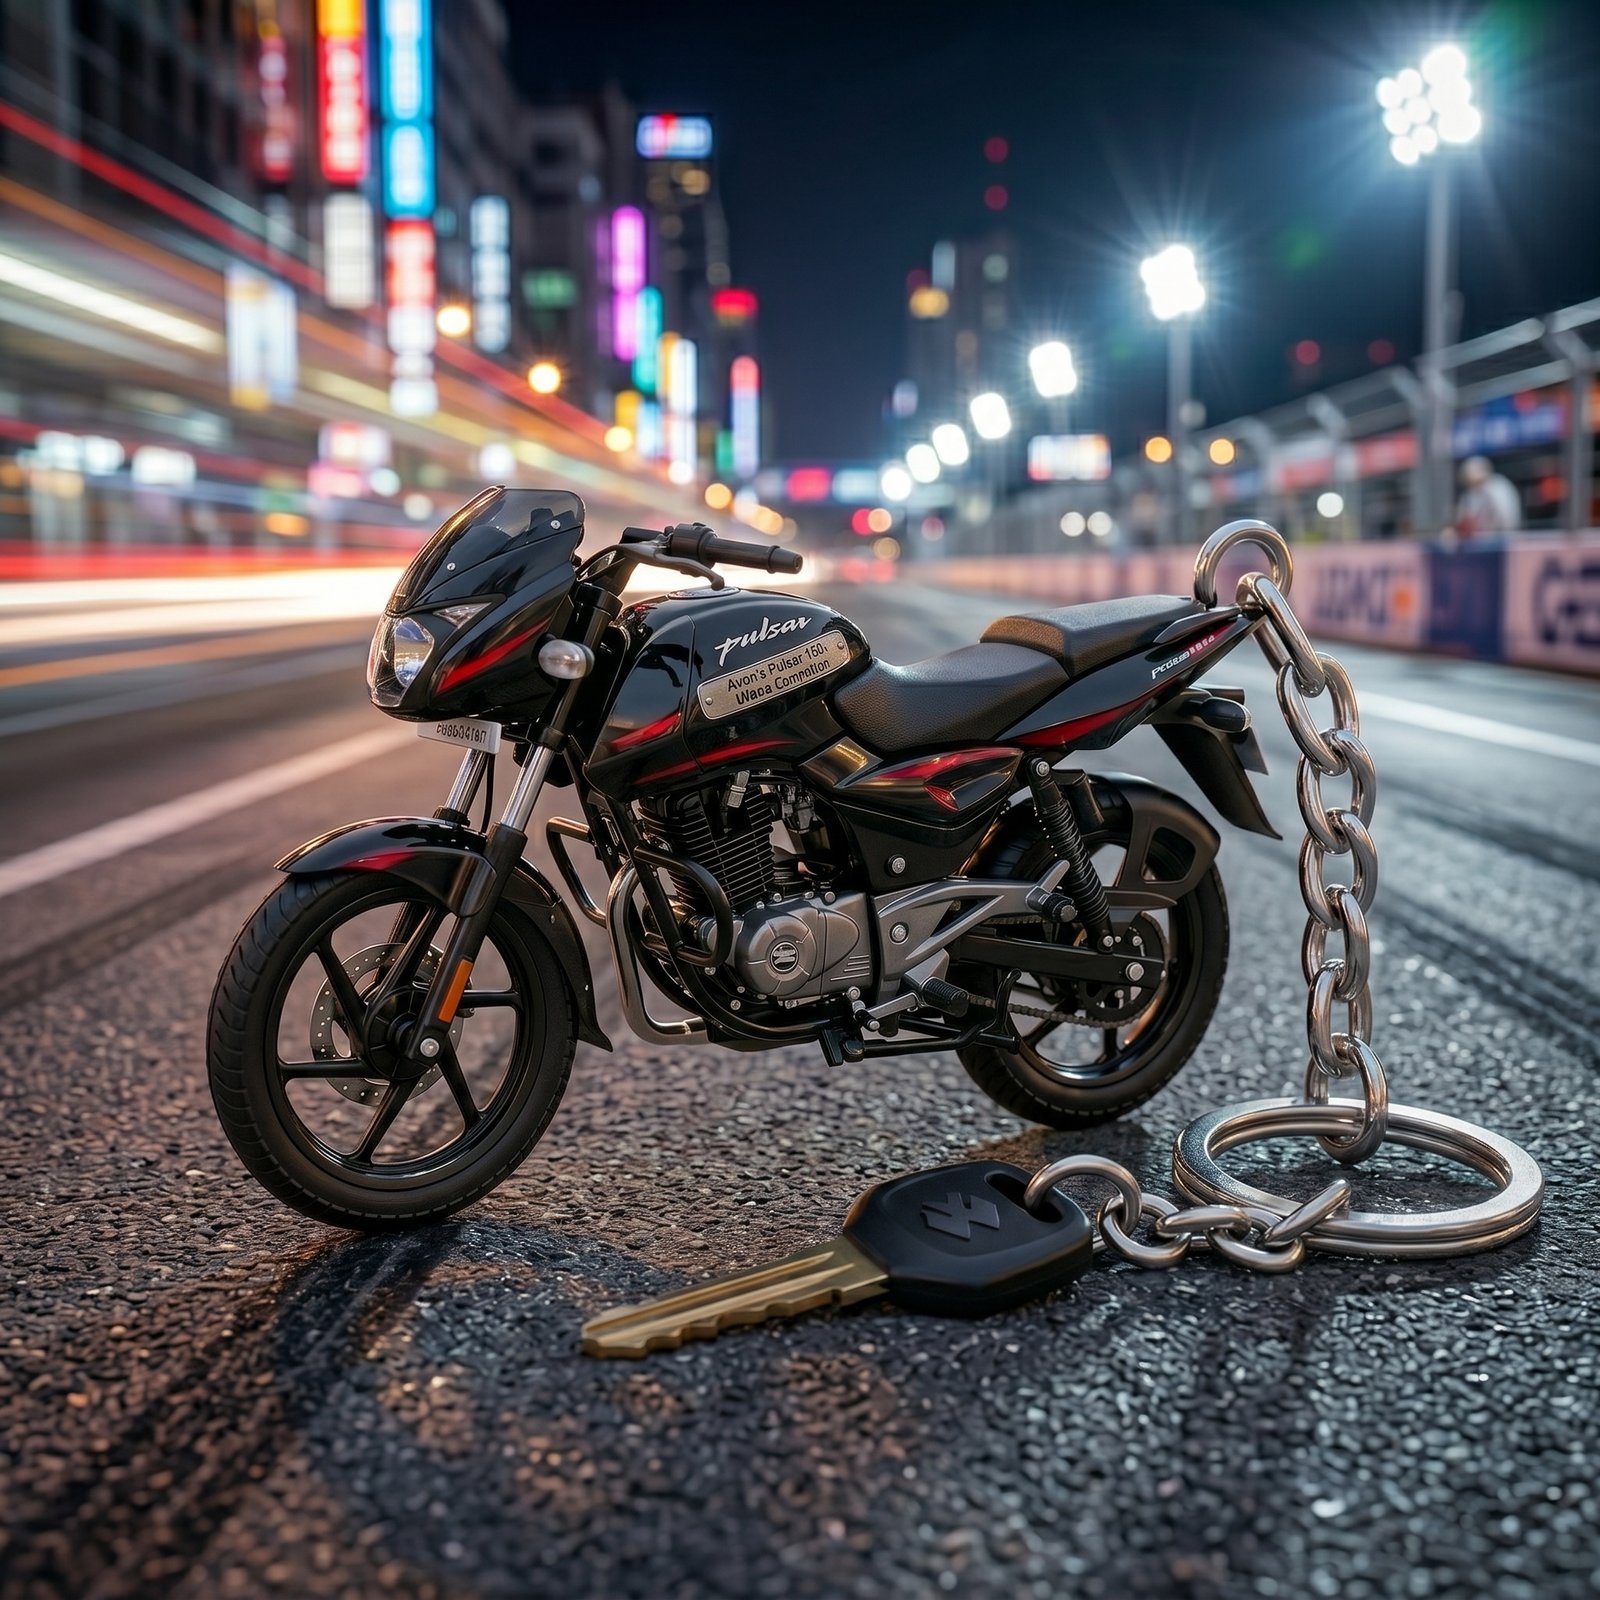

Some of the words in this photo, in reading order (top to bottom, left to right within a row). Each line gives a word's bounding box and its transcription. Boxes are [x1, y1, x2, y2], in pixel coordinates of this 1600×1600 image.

[714, 616, 812, 667] pulsar
[727, 669, 767, 692] Avon's
[768, 653, 803, 676] Pulsar
